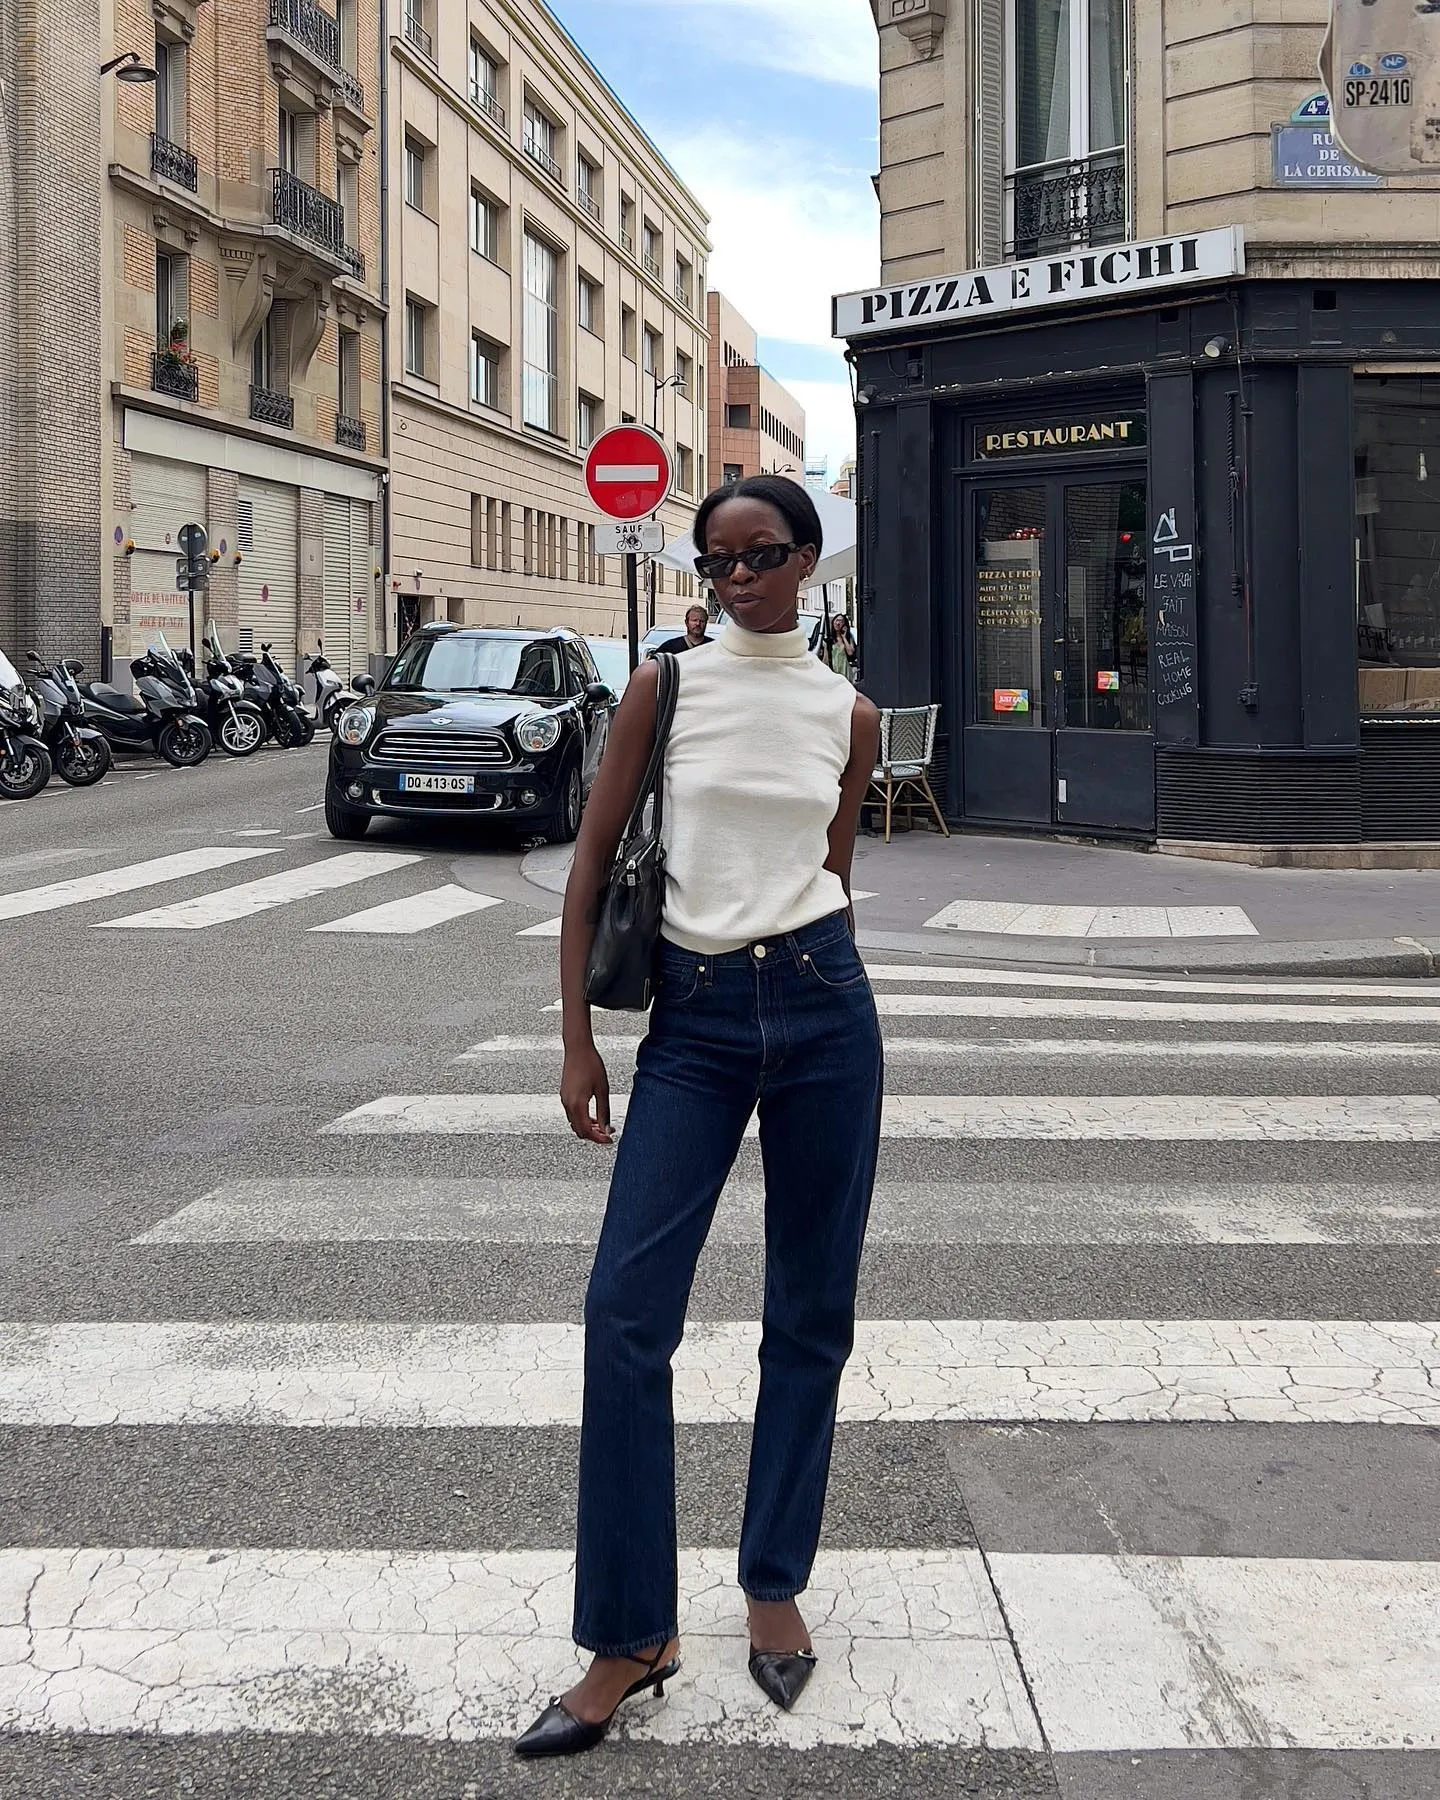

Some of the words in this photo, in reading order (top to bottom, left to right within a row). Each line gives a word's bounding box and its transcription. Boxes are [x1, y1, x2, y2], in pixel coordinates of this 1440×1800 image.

[1385, 56, 1404, 67] NF
[1346, 79, 1410, 106] SP-2410
[1312, 133, 1334, 146] RU
[1319, 149, 1339, 161] DE
[861, 275, 994, 324] PIZZA
[1011, 267, 1030, 300] E
[1047, 238, 1200, 294] FICHI
[986, 420, 1133, 451] RESTAURANT
[615, 524, 643, 534] SAUF
[1154, 573, 1168, 589] LE
[1158, 650, 1190, 669] REAL
[1163, 665, 1192, 686] HOME
[407, 776, 466, 790] DQ-413-QS
